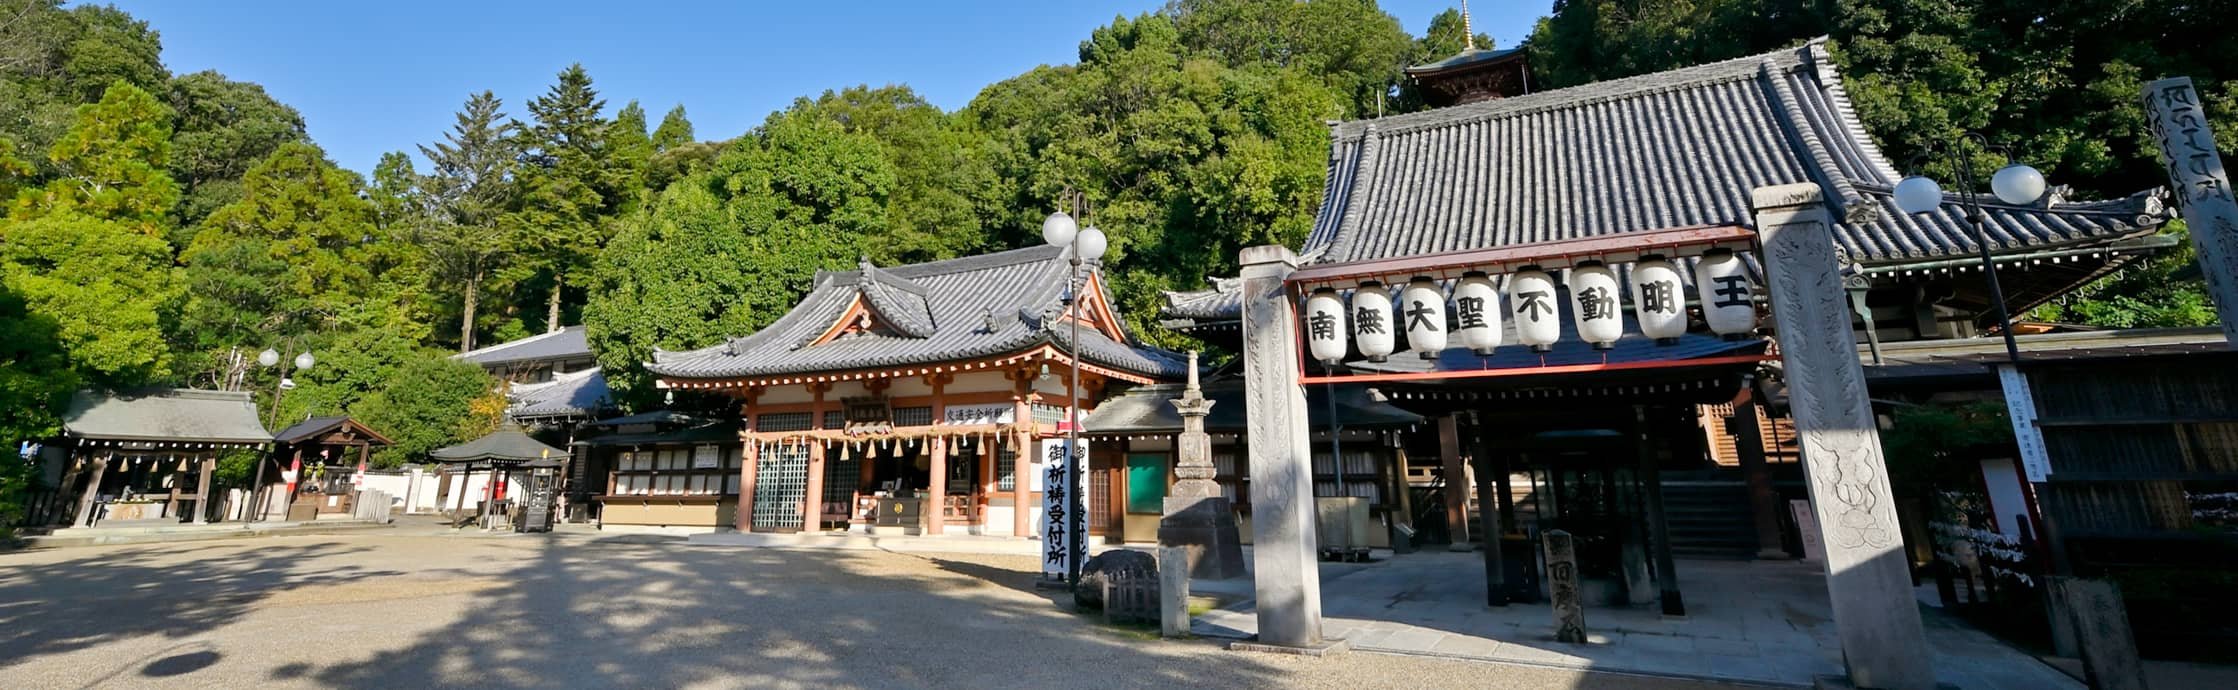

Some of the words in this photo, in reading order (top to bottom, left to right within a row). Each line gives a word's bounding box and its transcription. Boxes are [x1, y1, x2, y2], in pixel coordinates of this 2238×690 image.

[1309, 275, 1753, 341] 南無大聖不動明王
[1047, 444, 1067, 568] 御祈祷受付所
